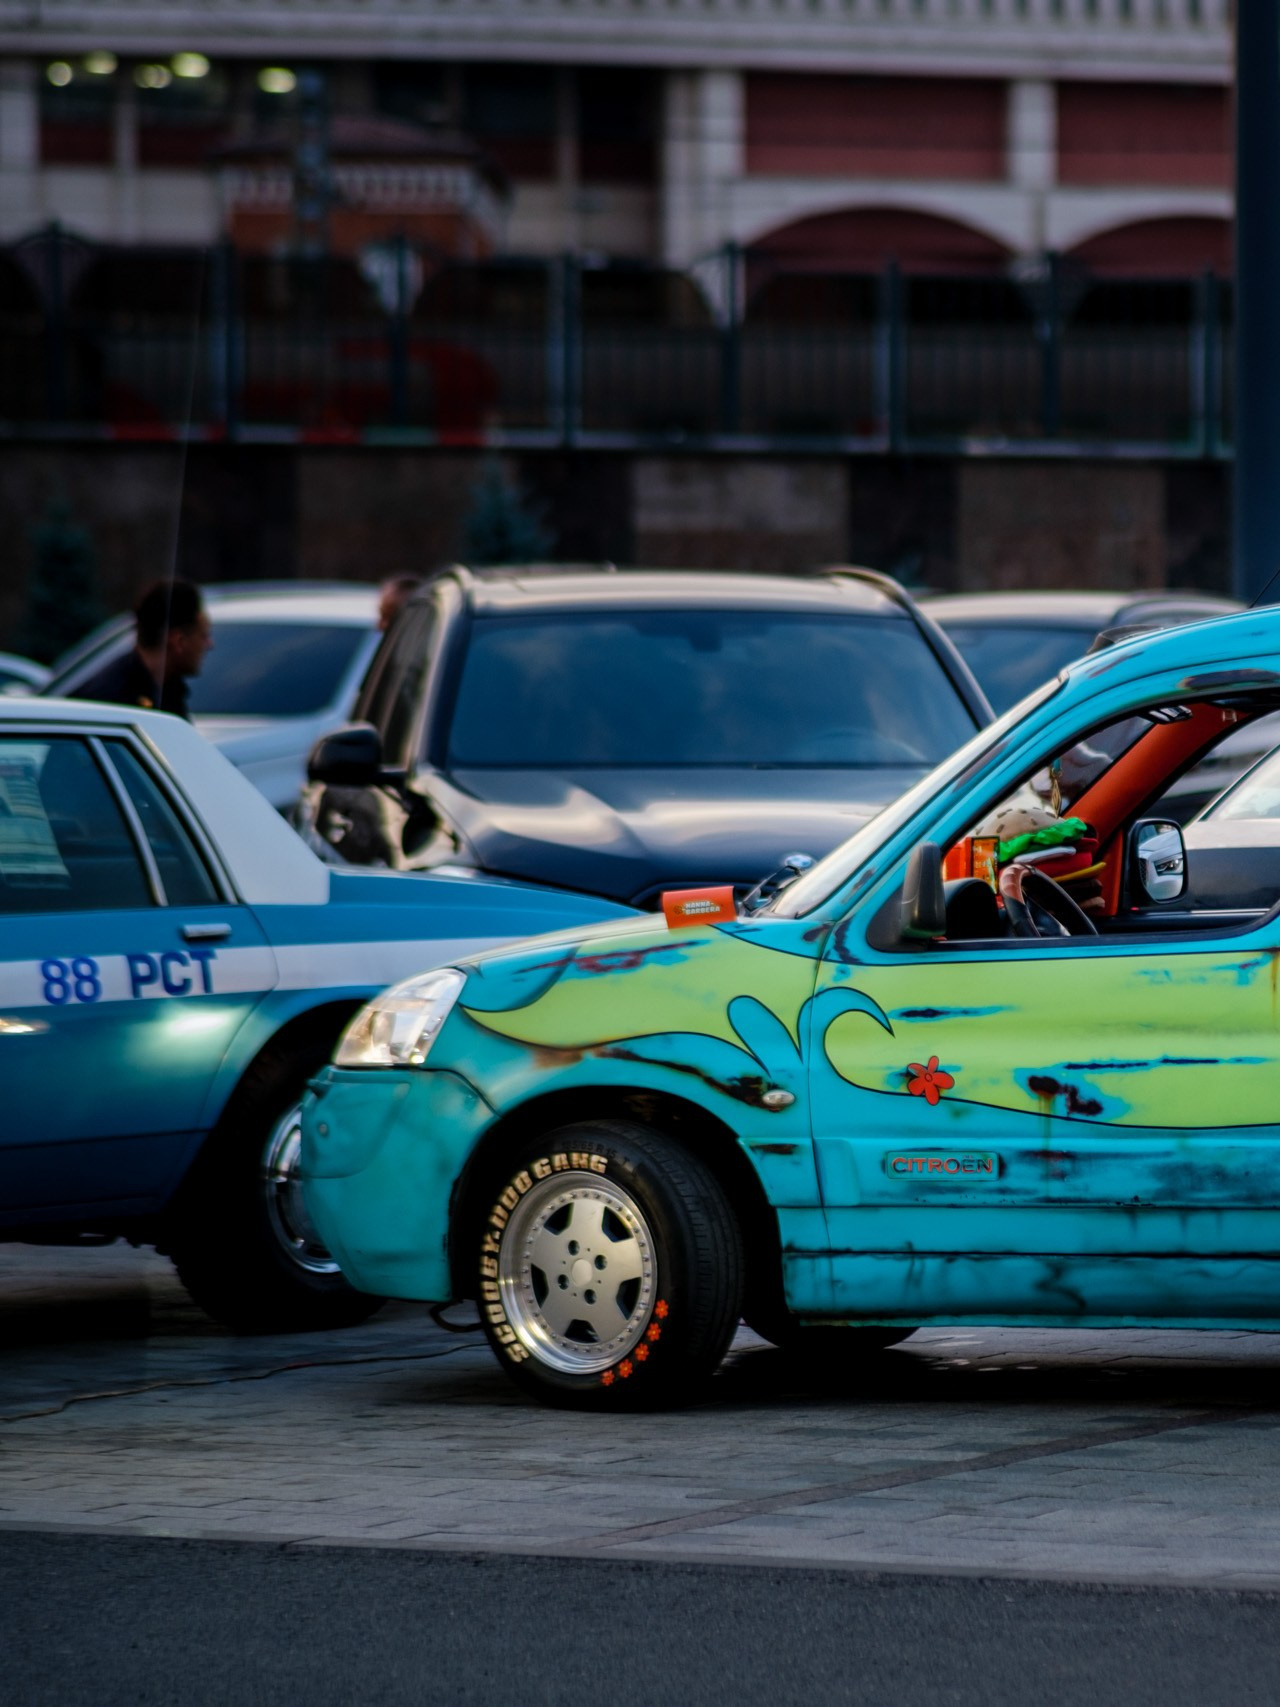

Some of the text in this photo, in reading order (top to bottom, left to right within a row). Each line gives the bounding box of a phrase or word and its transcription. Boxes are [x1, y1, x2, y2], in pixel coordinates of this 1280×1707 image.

[685, 905, 720, 915] BARBERA
[41, 949, 217, 1005] 88 PCT
[530, 1152, 609, 1180] GANG
[891, 1154, 993, 1174] CITROËN
